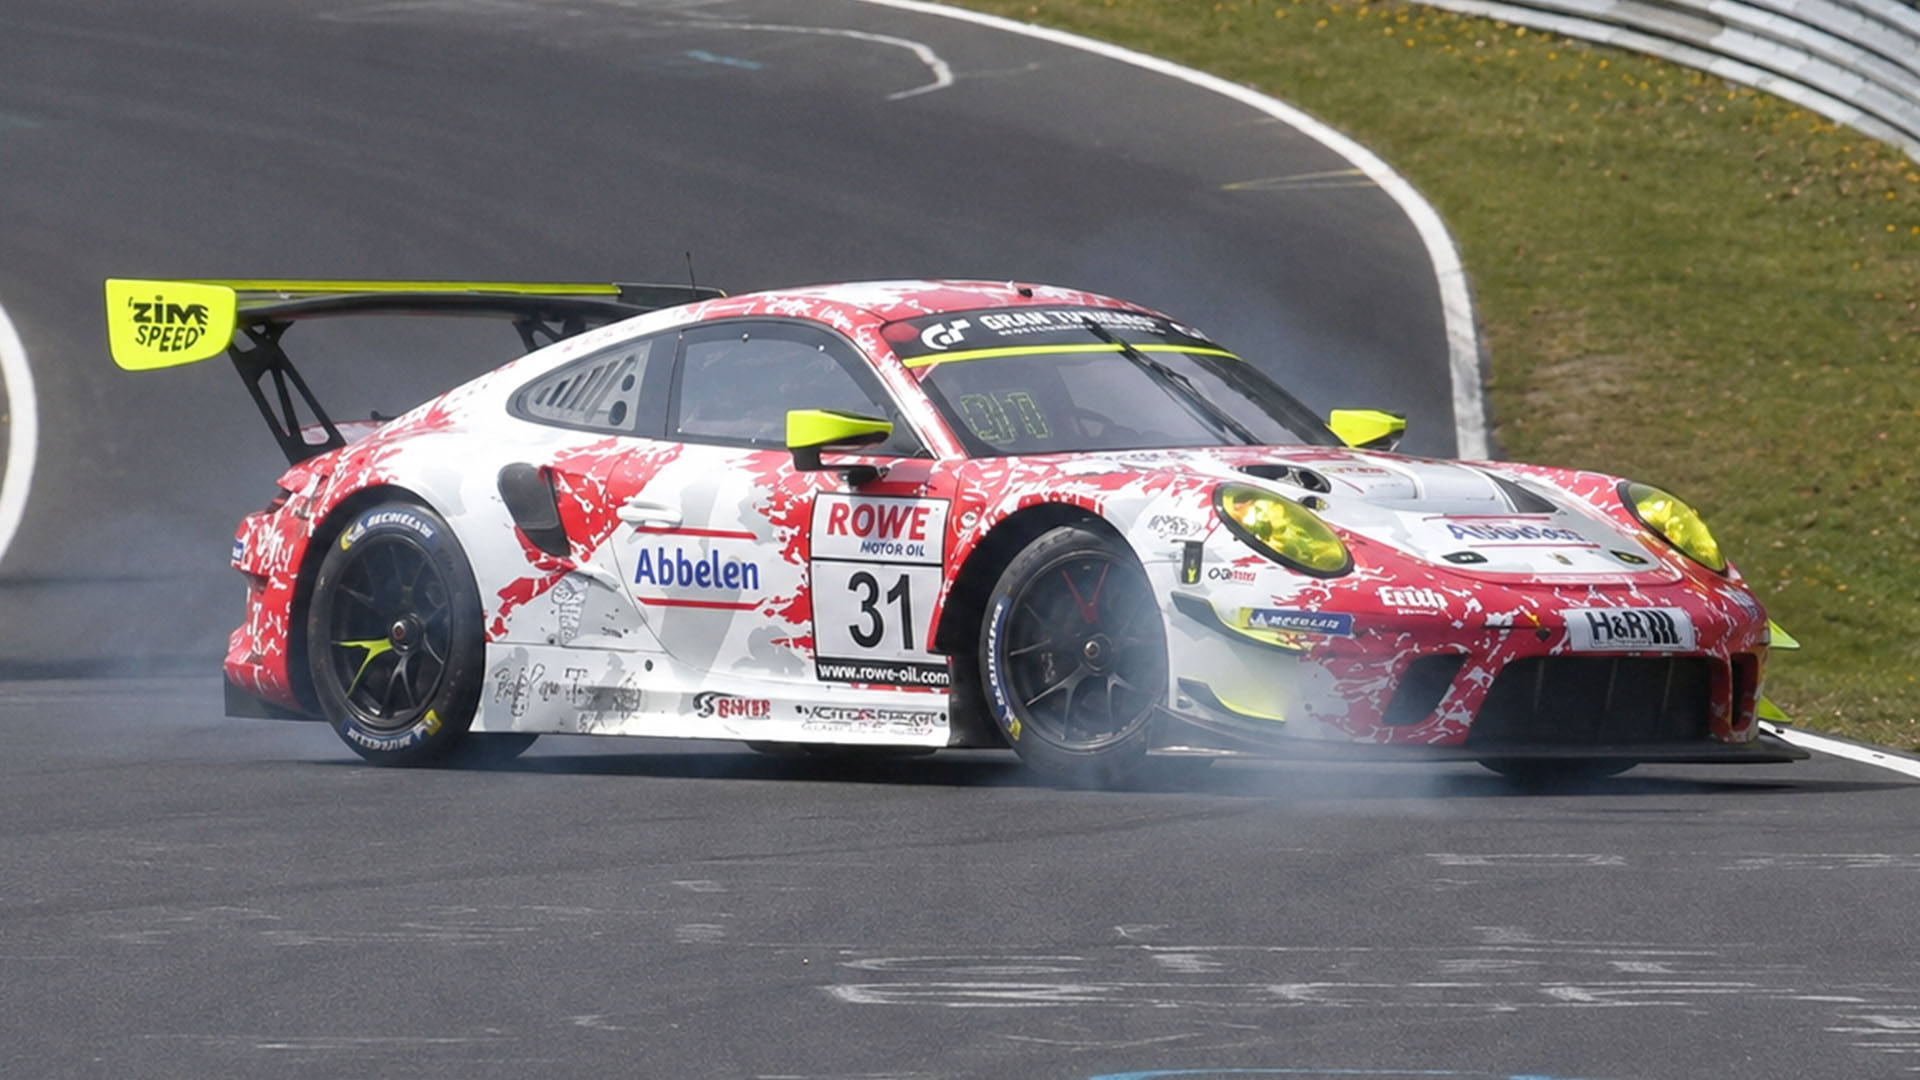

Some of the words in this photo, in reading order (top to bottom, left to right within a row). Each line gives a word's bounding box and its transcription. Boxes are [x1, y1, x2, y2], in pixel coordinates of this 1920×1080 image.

[979, 312, 1050, 330] GRAN
[827, 503, 930, 541] ROWE
[859, 541, 904, 556] MOTOR
[906, 543, 925, 557] OIL
[634, 546, 759, 590] Abbelen
[847, 571, 915, 650] 31
[818, 664, 949, 684] www.rowe-oil.com
